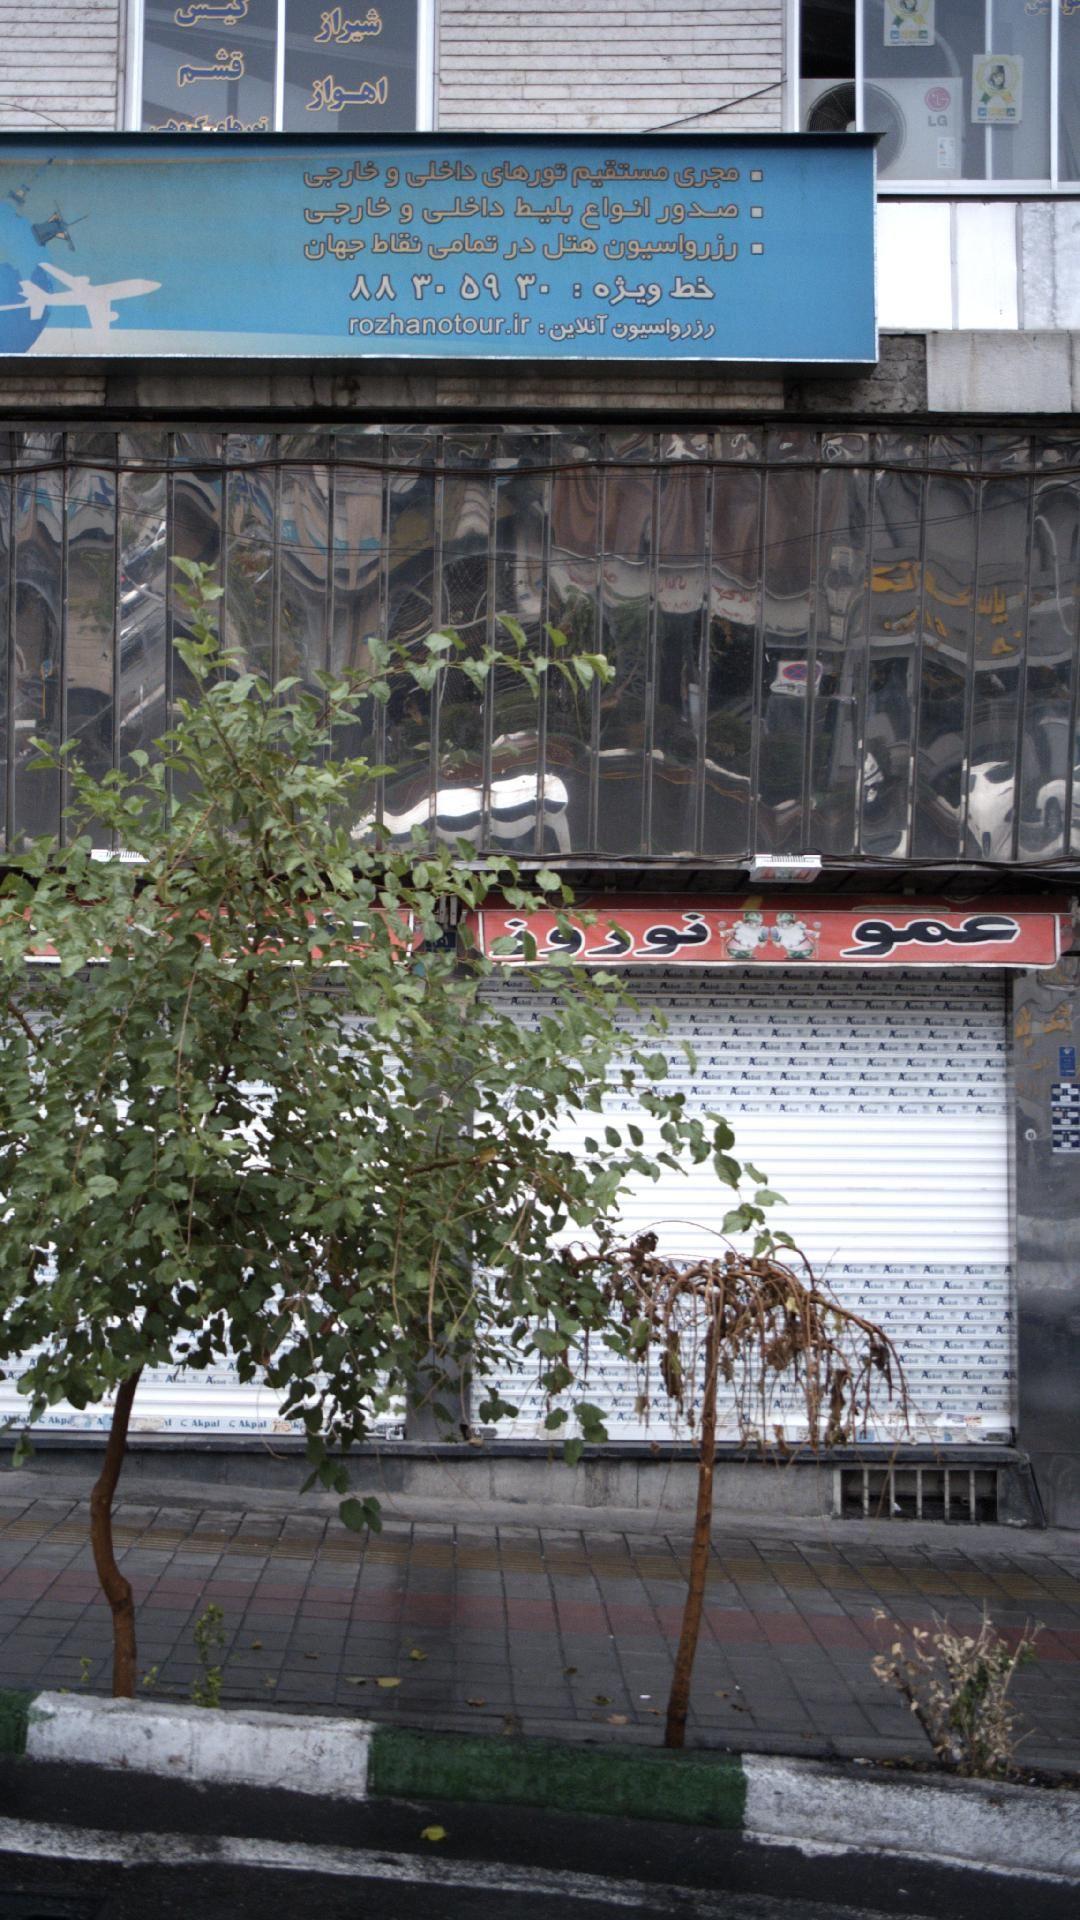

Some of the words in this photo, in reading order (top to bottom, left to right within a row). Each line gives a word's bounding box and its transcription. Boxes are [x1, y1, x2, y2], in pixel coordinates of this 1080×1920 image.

[314, 9, 383, 42] شیراز
[177, 48, 245, 87] قشم
[306, 75, 388, 112] اهواز
[927, 114, 948, 128] LG
[303, 160, 380, 189] خارجی
[384, 165, 400, 188] و
[405, 160, 478, 188] داخلی
[481, 160, 568, 188] تورهای
[571, 159, 670, 188] مستقیم
[674, 165, 740, 189] مجری
[303, 196, 392, 225] خارجی
[399, 202, 414, 225] و
[422, 196, 505, 224] داخلی
[514, 196, 574, 225] بلیط
[579, 196, 651, 230] انواع
[656, 201, 740, 225] صدور
[303, 232, 367, 261] جهان
[371, 232, 423, 255] نقاط
[427, 232, 499, 261] تمامی
[502, 236, 537, 261] در
[542, 232, 599, 261] هتل
[603, 232, 739, 262] رزرواسیون
[349, 273, 397, 301] ۸۸
[410, 273, 446, 301] ۳۰
[459, 272, 502, 301] ۵۹
[515, 273, 551, 301] ۳۰
[592, 275, 663, 308] ویژه
[668, 275, 717, 300] خط
[348, 312, 532, 336] rozhanotour.ir
[611, 317, 717, 343] رزرواسیون
[839, 914, 1021, 958] عمو
